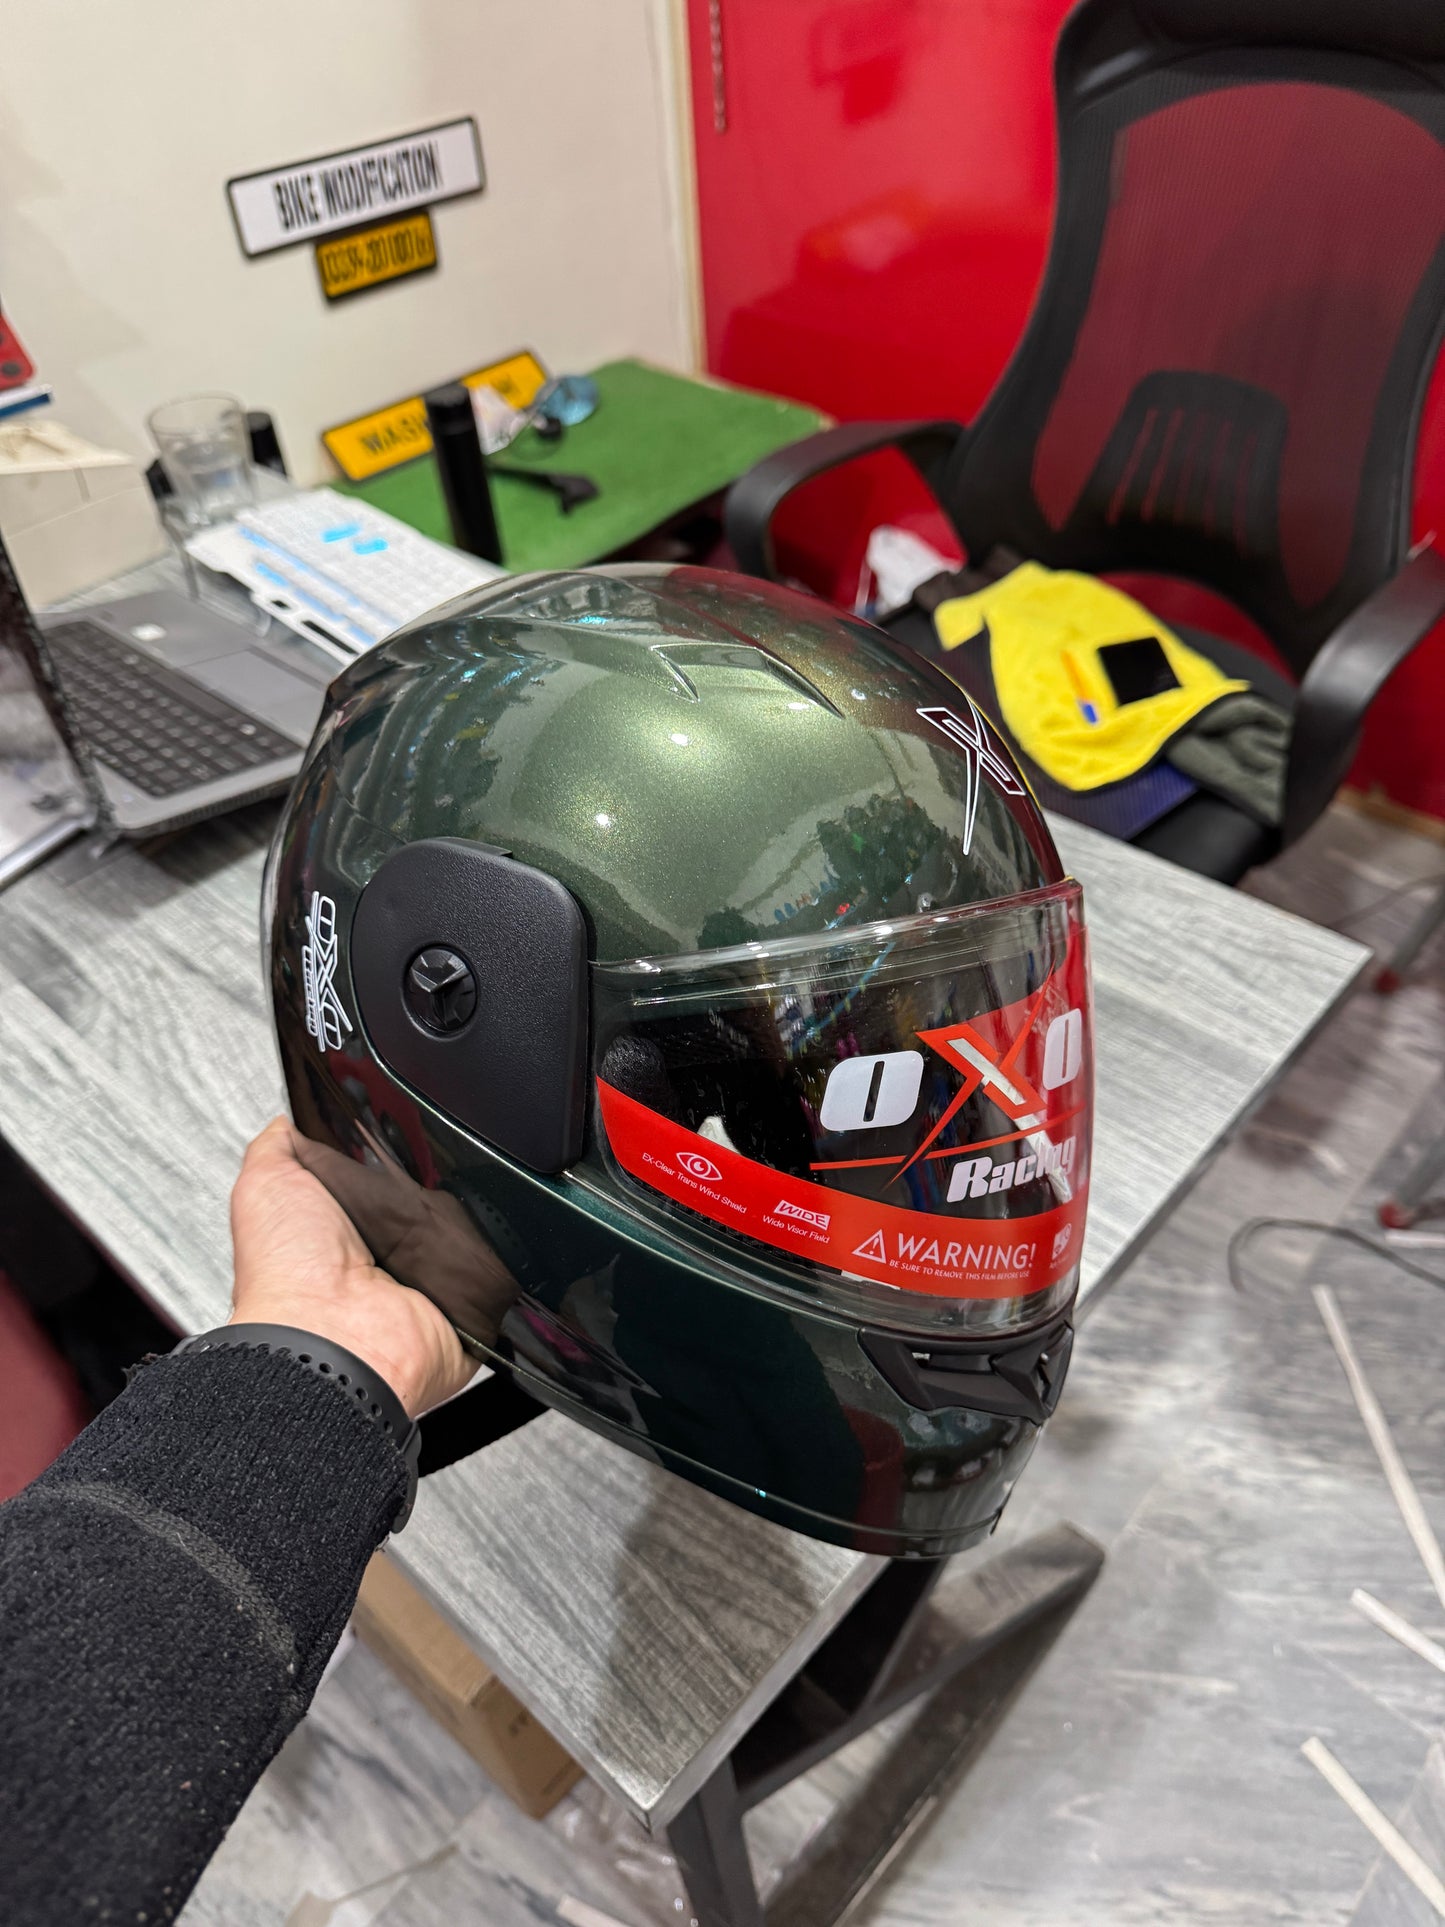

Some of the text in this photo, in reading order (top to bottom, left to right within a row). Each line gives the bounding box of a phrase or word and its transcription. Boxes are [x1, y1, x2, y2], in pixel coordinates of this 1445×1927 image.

[272, 172, 320, 232] BIKE
[819, 970, 1084, 1180] OXO
[642, 1152, 747, 1214] EX-Clear Trans Wind Shield
[946, 1136, 1077, 1203] Racing
[762, 1214, 785, 1229] Wide
[787, 1223, 808, 1237] Visor
[778, 1202, 827, 1228] WIDE
[889, 1259, 900, 1268] BE
[900, 1262, 921, 1273] SURE
[923, 1266, 934, 1275] TO
[934, 1269, 963, 1279] REMOVE
[965, 1272, 981, 1281] THIS
[898, 1232, 1037, 1270] WARNING!
